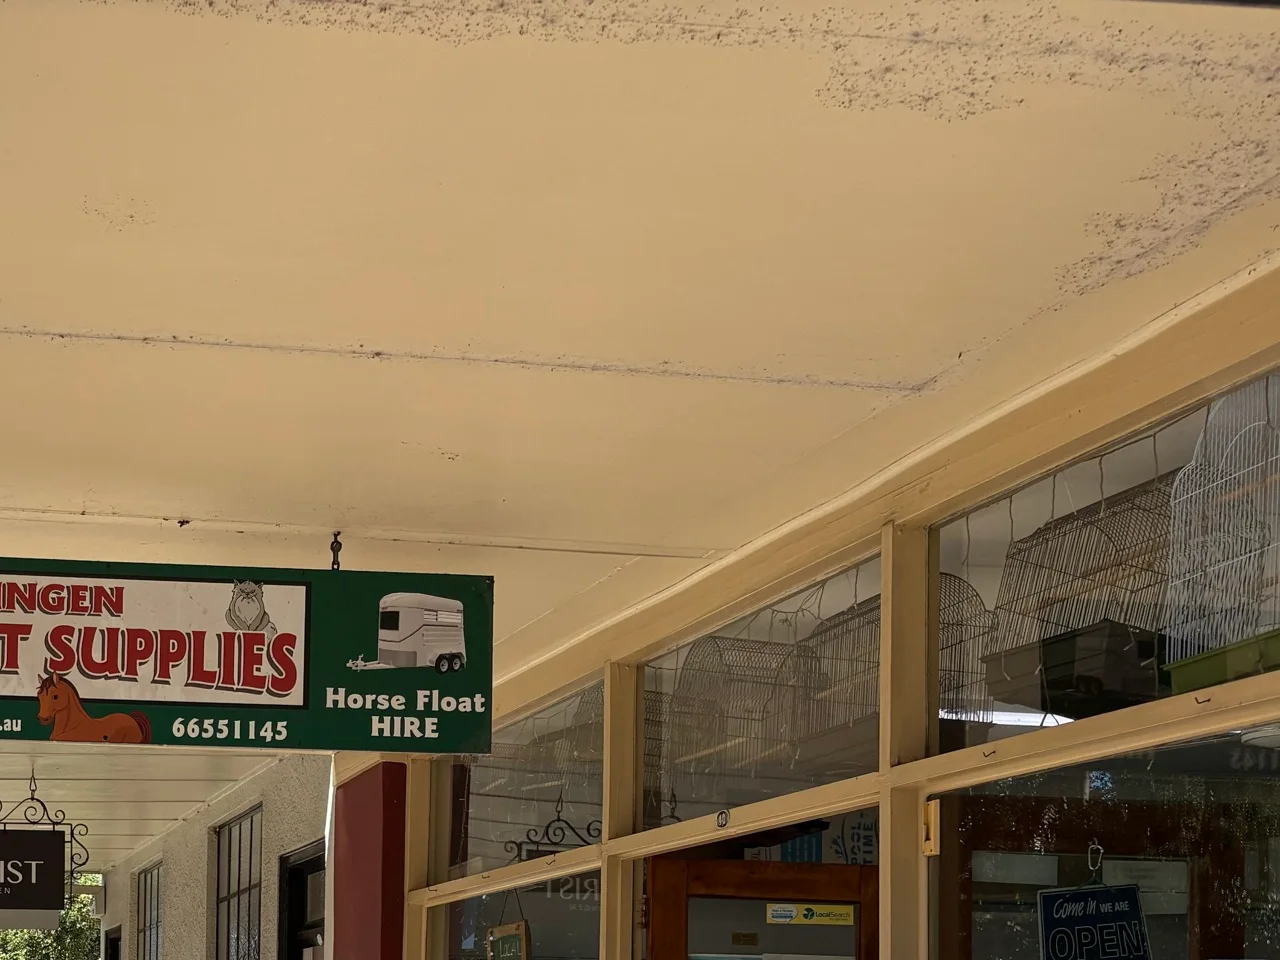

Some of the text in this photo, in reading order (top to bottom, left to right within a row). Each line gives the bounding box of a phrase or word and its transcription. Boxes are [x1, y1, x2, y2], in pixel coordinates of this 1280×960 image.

[45, 625, 298, 698] SUPPLIES
[325, 687, 486, 713] Horse Float
[172, 717, 288, 743] 66551145
[370, 716, 439, 738] HIRE
[815, 910, 851, 919] LocalSearch
[1053, 897, 1130, 918] Come in WE ARE
[500, 940, 521, 957] LOCAL
